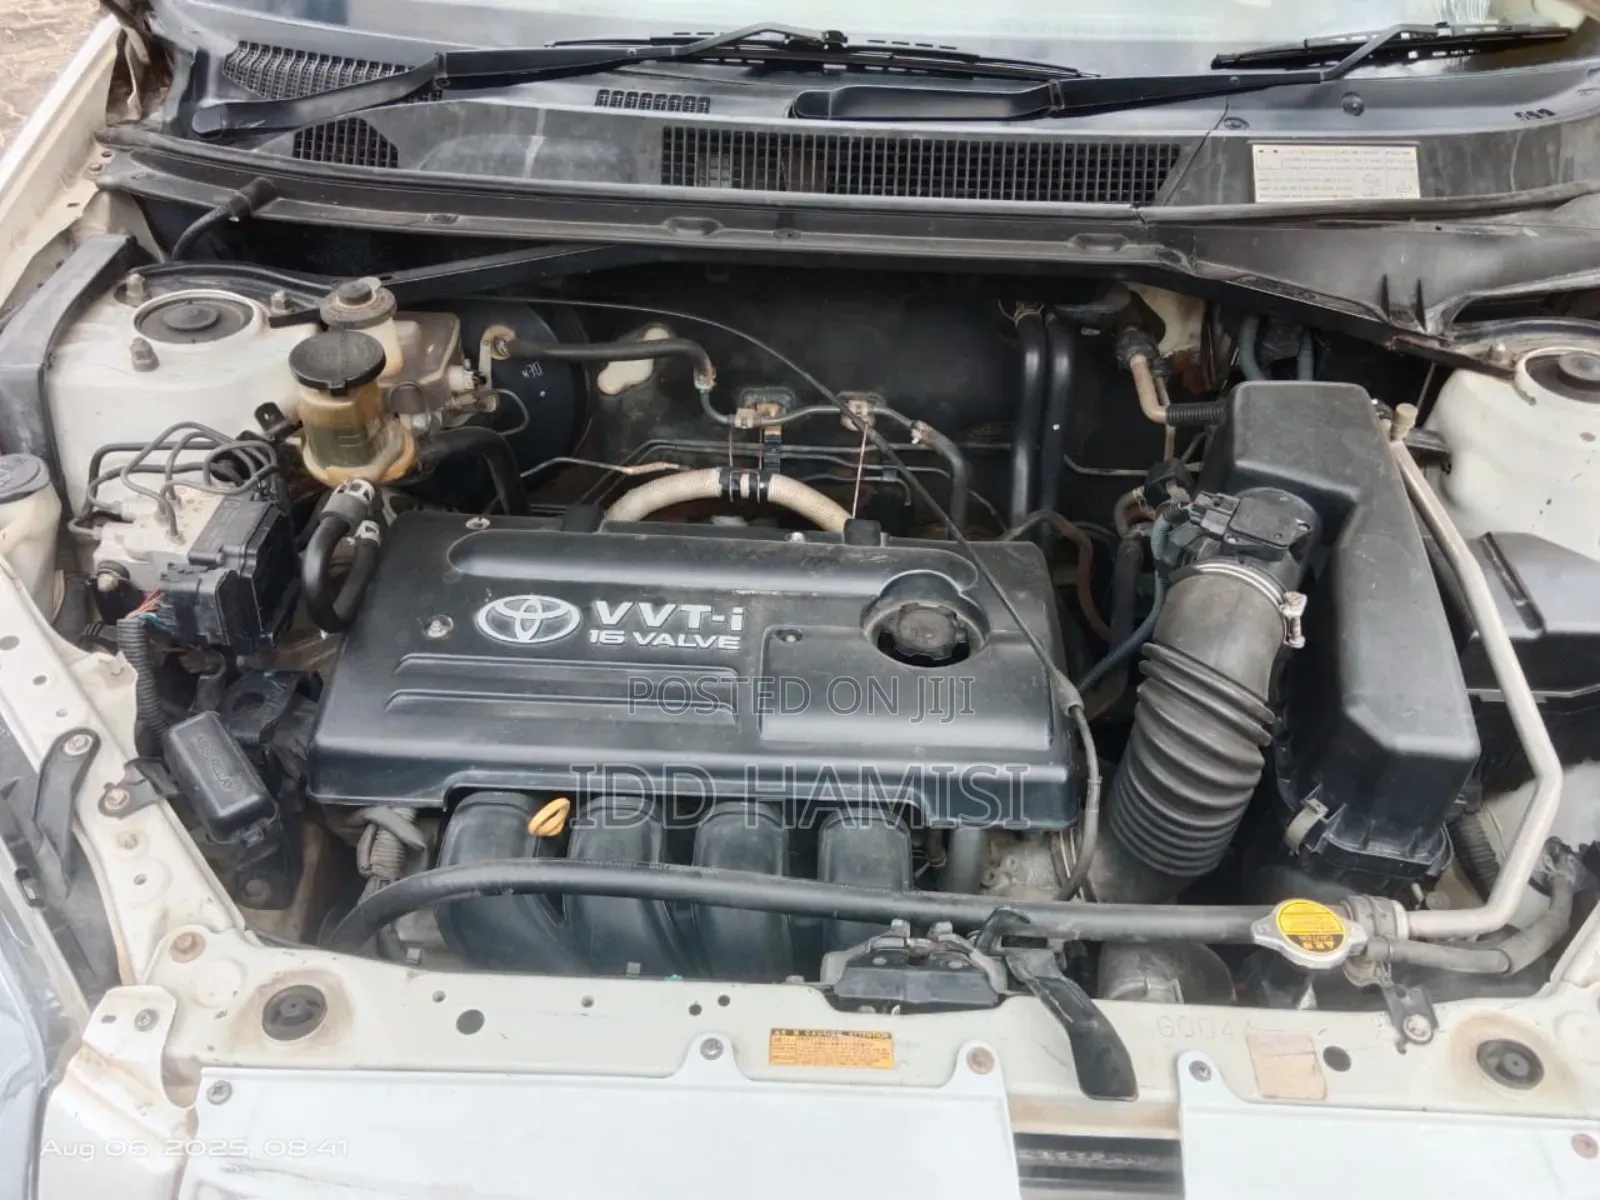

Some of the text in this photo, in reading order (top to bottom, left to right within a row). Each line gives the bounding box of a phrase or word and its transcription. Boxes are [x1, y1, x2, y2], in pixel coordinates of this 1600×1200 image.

[595, 600, 744, 631] VVT-i
[590, 629, 741, 650] 16 VALVE
